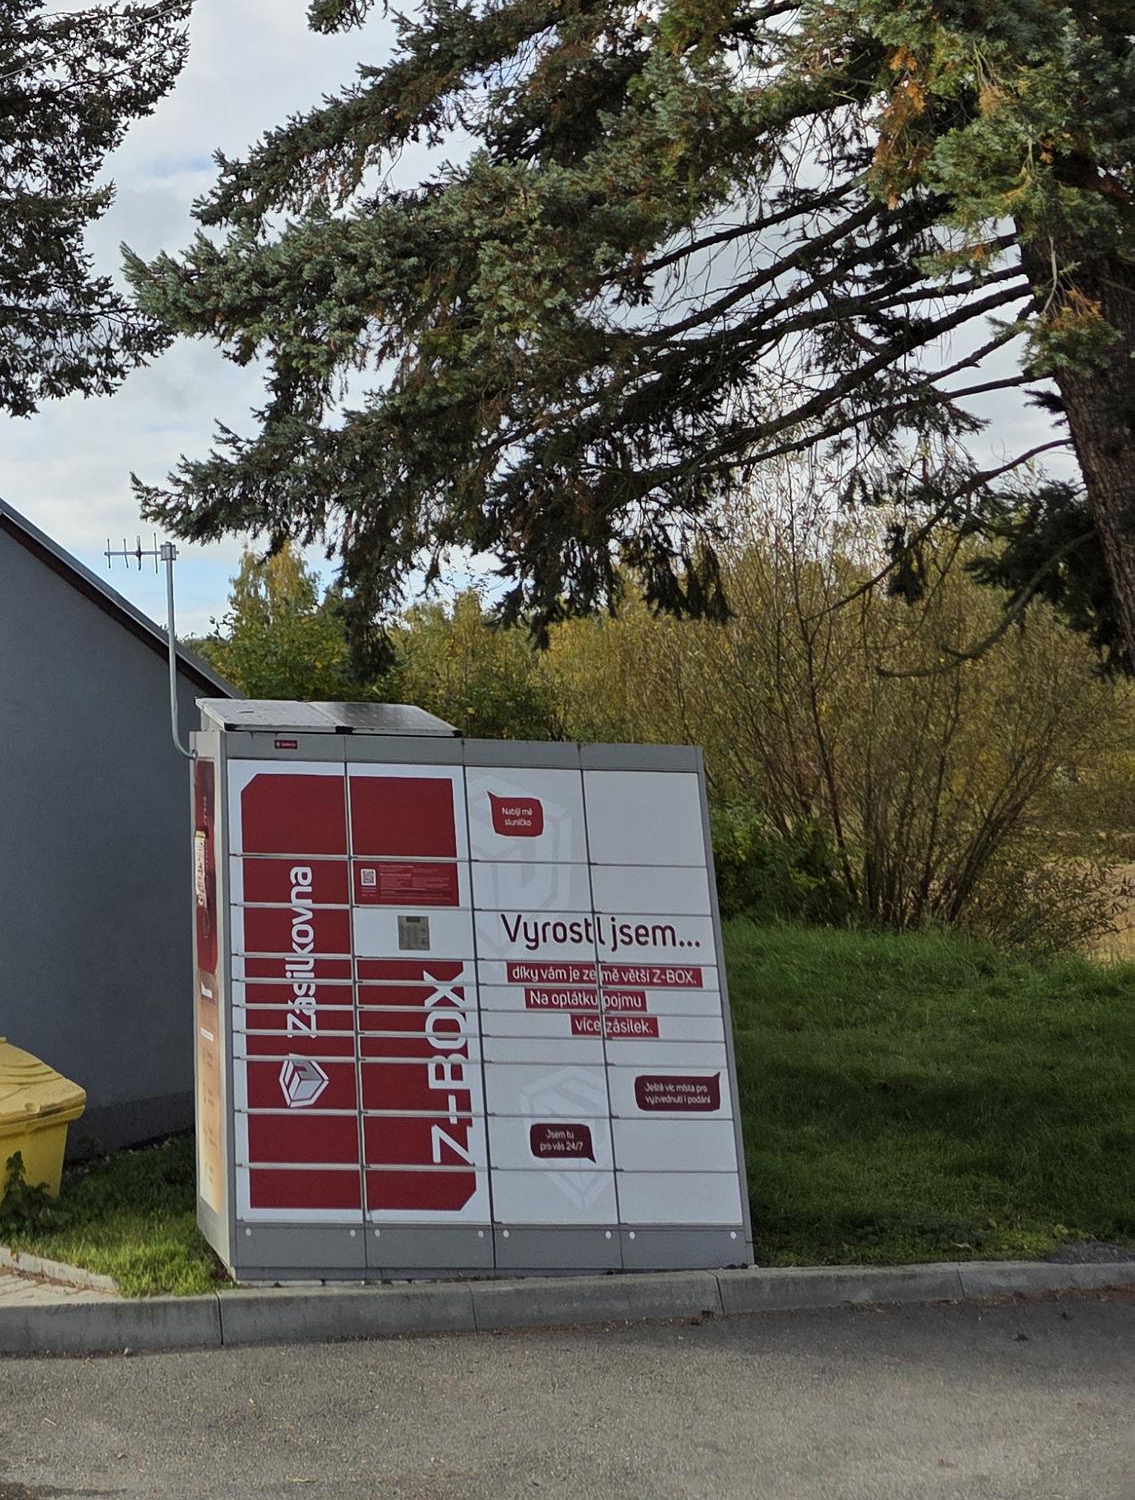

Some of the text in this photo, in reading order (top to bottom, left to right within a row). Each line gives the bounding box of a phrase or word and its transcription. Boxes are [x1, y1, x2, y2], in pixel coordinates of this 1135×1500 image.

[500, 913, 702, 952] Vyrostl jsem...
[284, 866, 317, 1039] Zásilkovna
[512, 965, 698, 984] díky vám je ze mě větší Z-BOX.
[529, 990, 642, 1010] Na oplátku pojmu
[575, 1017, 654, 1034] více zásilek.
[423, 970, 476, 1166] Z-BOX
[696, 1085, 708, 1094] pro
[545, 1129, 575, 1139] Jsem tu
[539, 1143, 552, 1152] pro
[566, 1141, 584, 1151] 24/7
